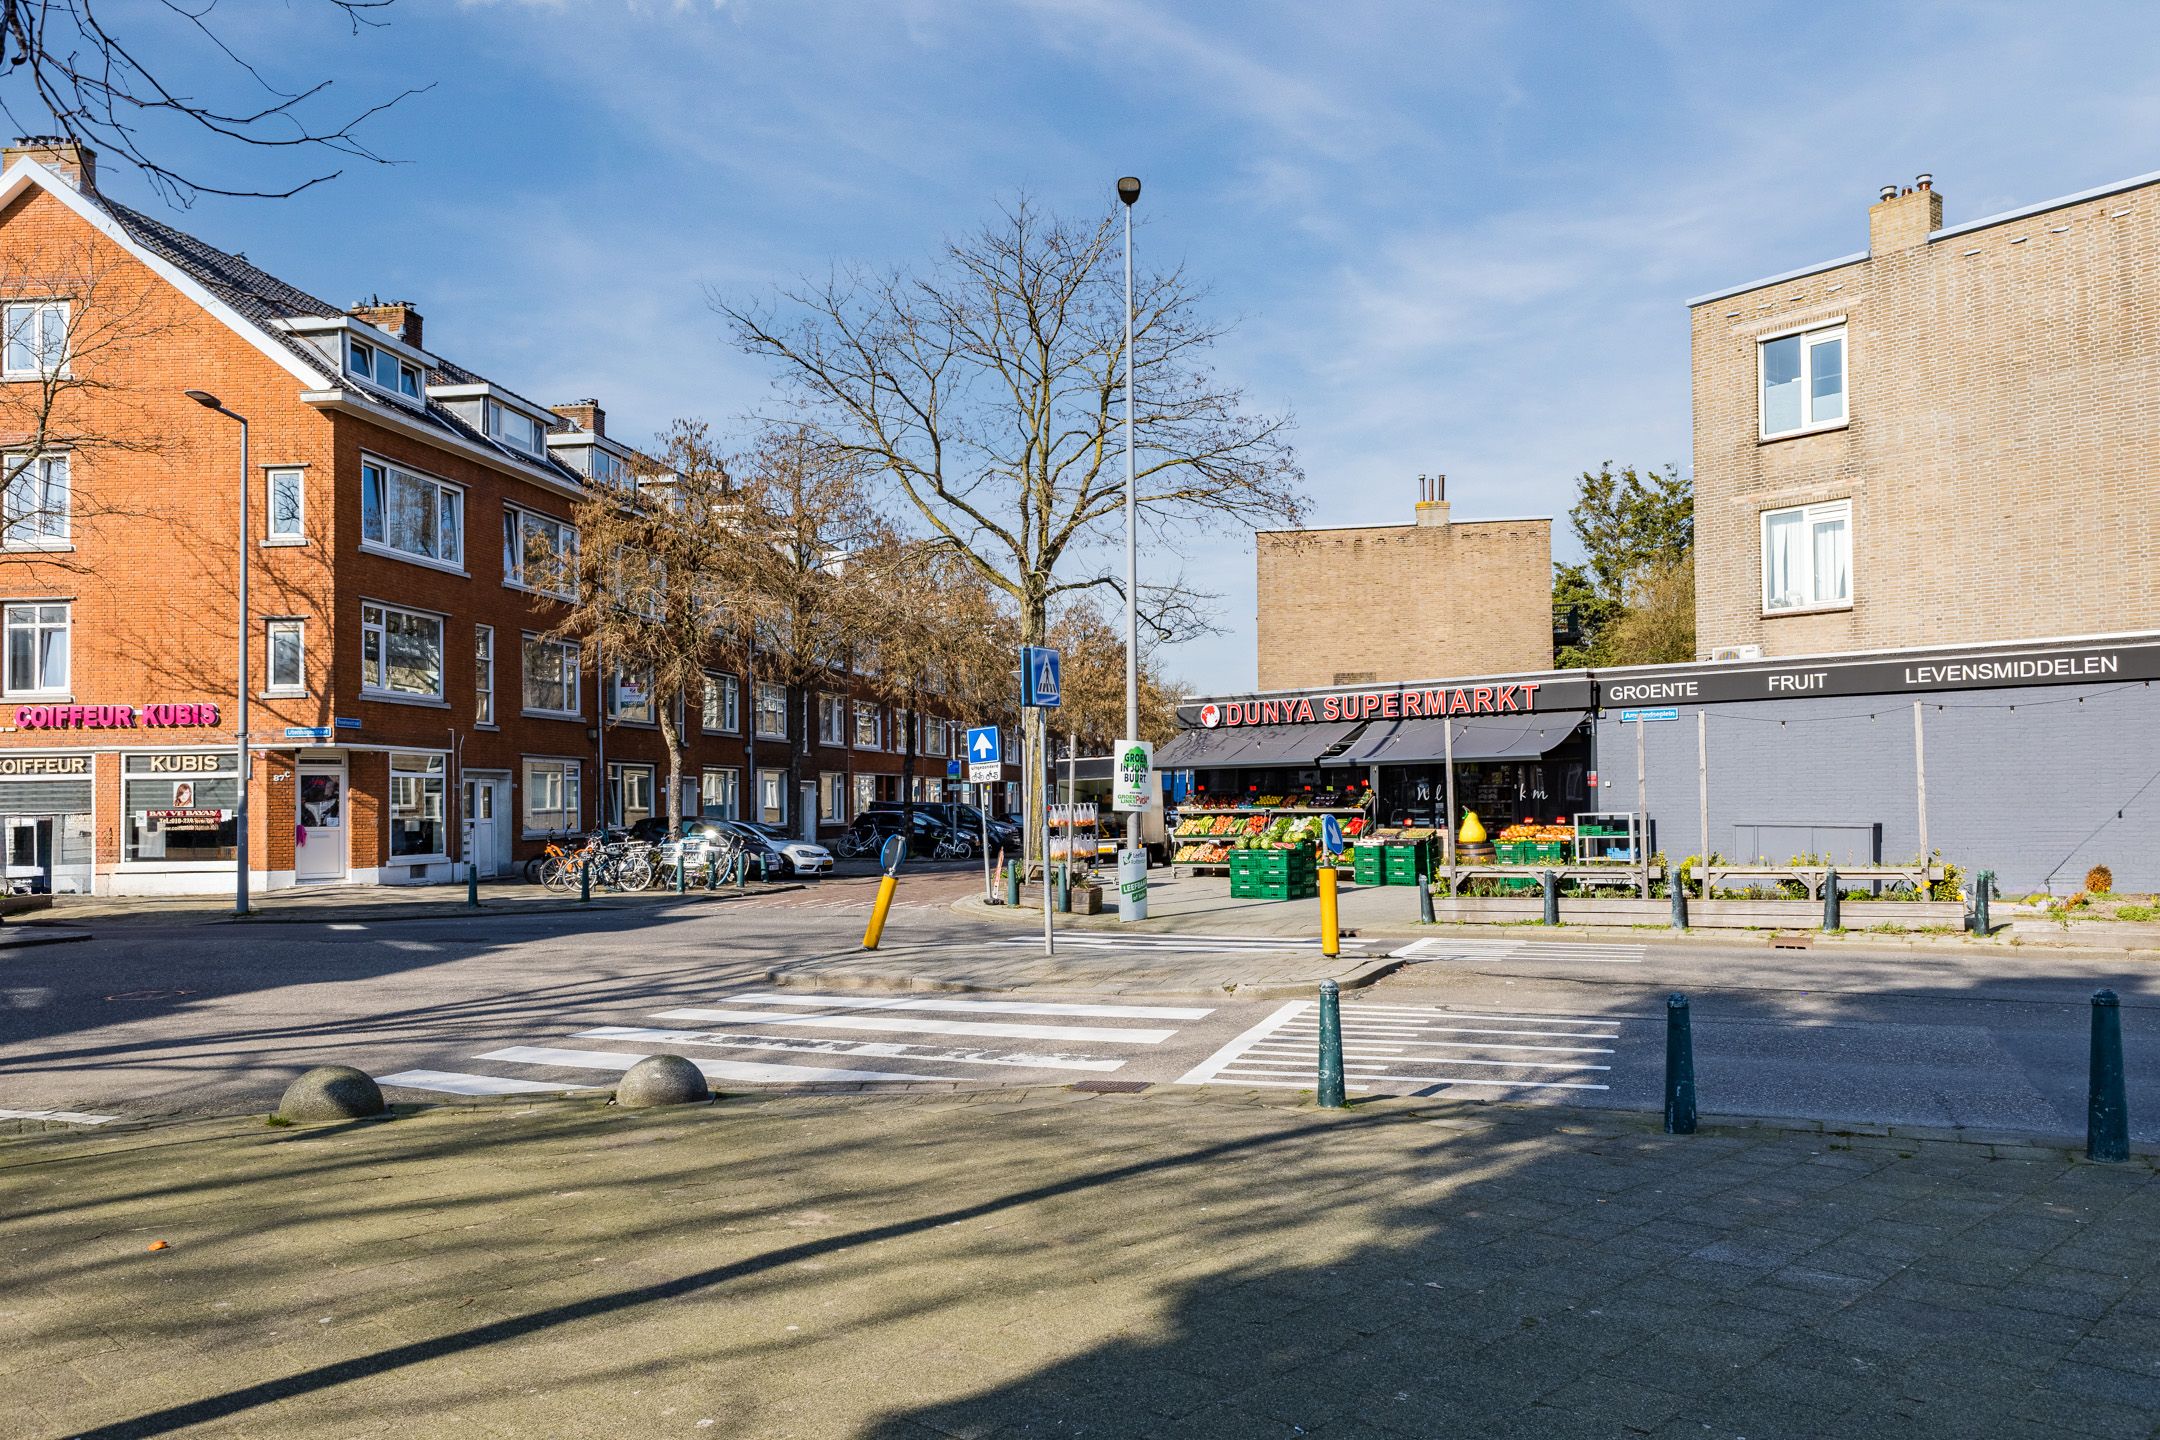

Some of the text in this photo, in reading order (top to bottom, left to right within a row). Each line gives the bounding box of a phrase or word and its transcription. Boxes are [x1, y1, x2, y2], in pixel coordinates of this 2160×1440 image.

[1905, 656, 2118, 684] LEVENSMIDDELEN
[1609, 681, 1699, 701] GROENTE
[1768, 673, 1828, 692] FRUIT
[1226, 684, 1540, 726] DUNYA SUPERMARKT
[15, 704, 218, 728] COIFFEUR KUBIS
[0, 758, 85, 774] OIFFEUR
[150, 755, 219, 772] KUBIS
[1124, 753, 1148, 764] GROEN
[1120, 763, 1149, 773] IN JOUW
[1124, 773, 1147, 783] BUURT
